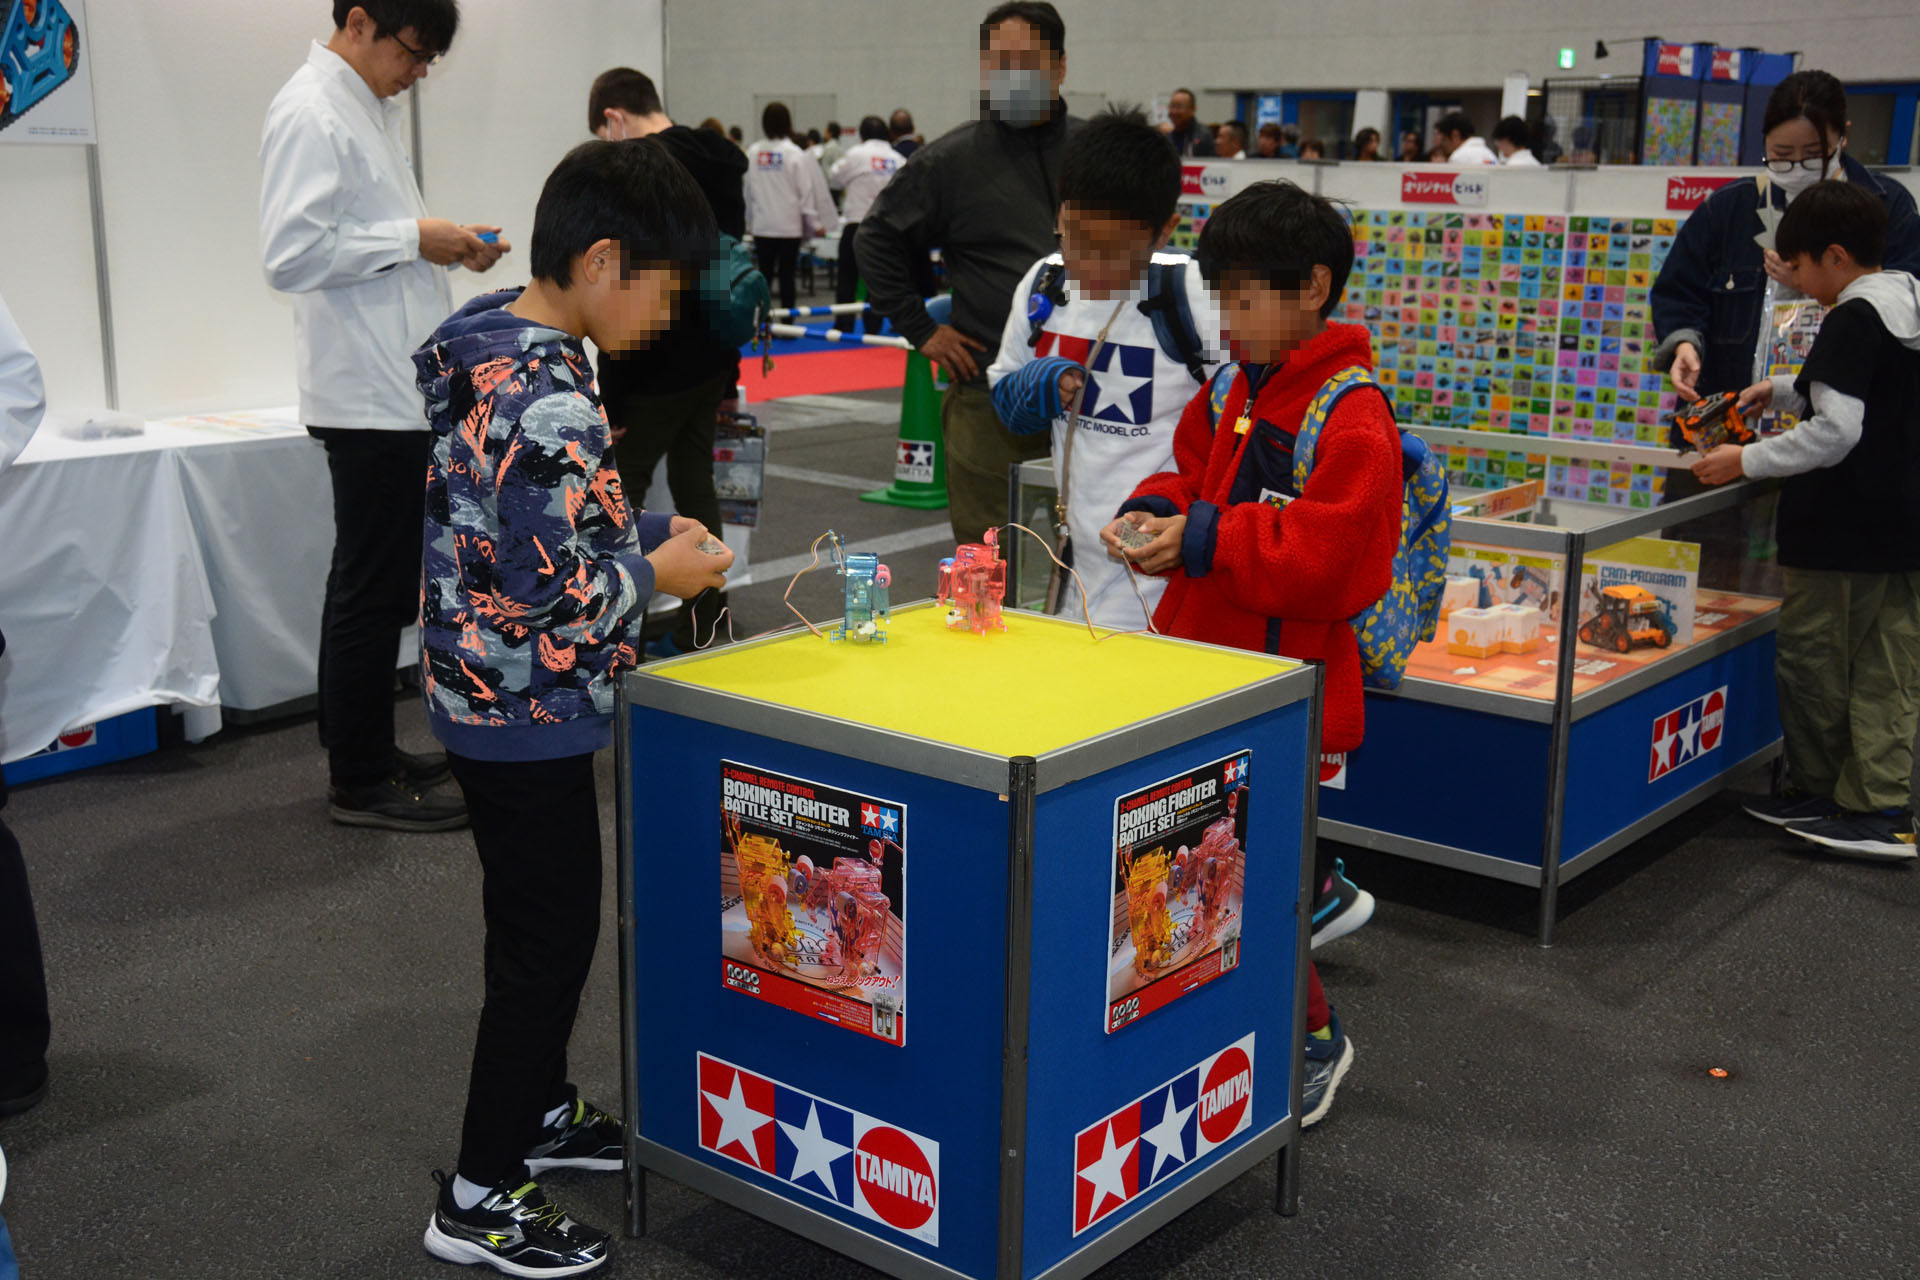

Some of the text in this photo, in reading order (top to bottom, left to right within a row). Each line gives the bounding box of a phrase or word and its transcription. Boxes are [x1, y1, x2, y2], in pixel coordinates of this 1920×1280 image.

[1093, 421, 1129, 437] MODEL
[1131, 426, 1152, 437] CO.
[1601, 566, 1687, 588] CAM-PROGRAM
[724, 767, 816, 799] 2-CHANNEL REMOTE CONTROL
[723, 777, 782, 810] BOXING
[783, 794, 850, 827] FIGHTER
[723, 796, 769, 821] BATTLE
[770, 808, 794, 827] SET
[1119, 798, 1167, 833] BOXING
[1168, 778, 1217, 813] FIGHTER
[1119, 821, 1157, 848] BATTLE
[1157, 811, 1176, 832] SET
[727, 963, 760, 985] ROBO
[1199, 1068, 1250, 1123] TAMIYA
[856, 1148, 934, 1209] TAMIYA
